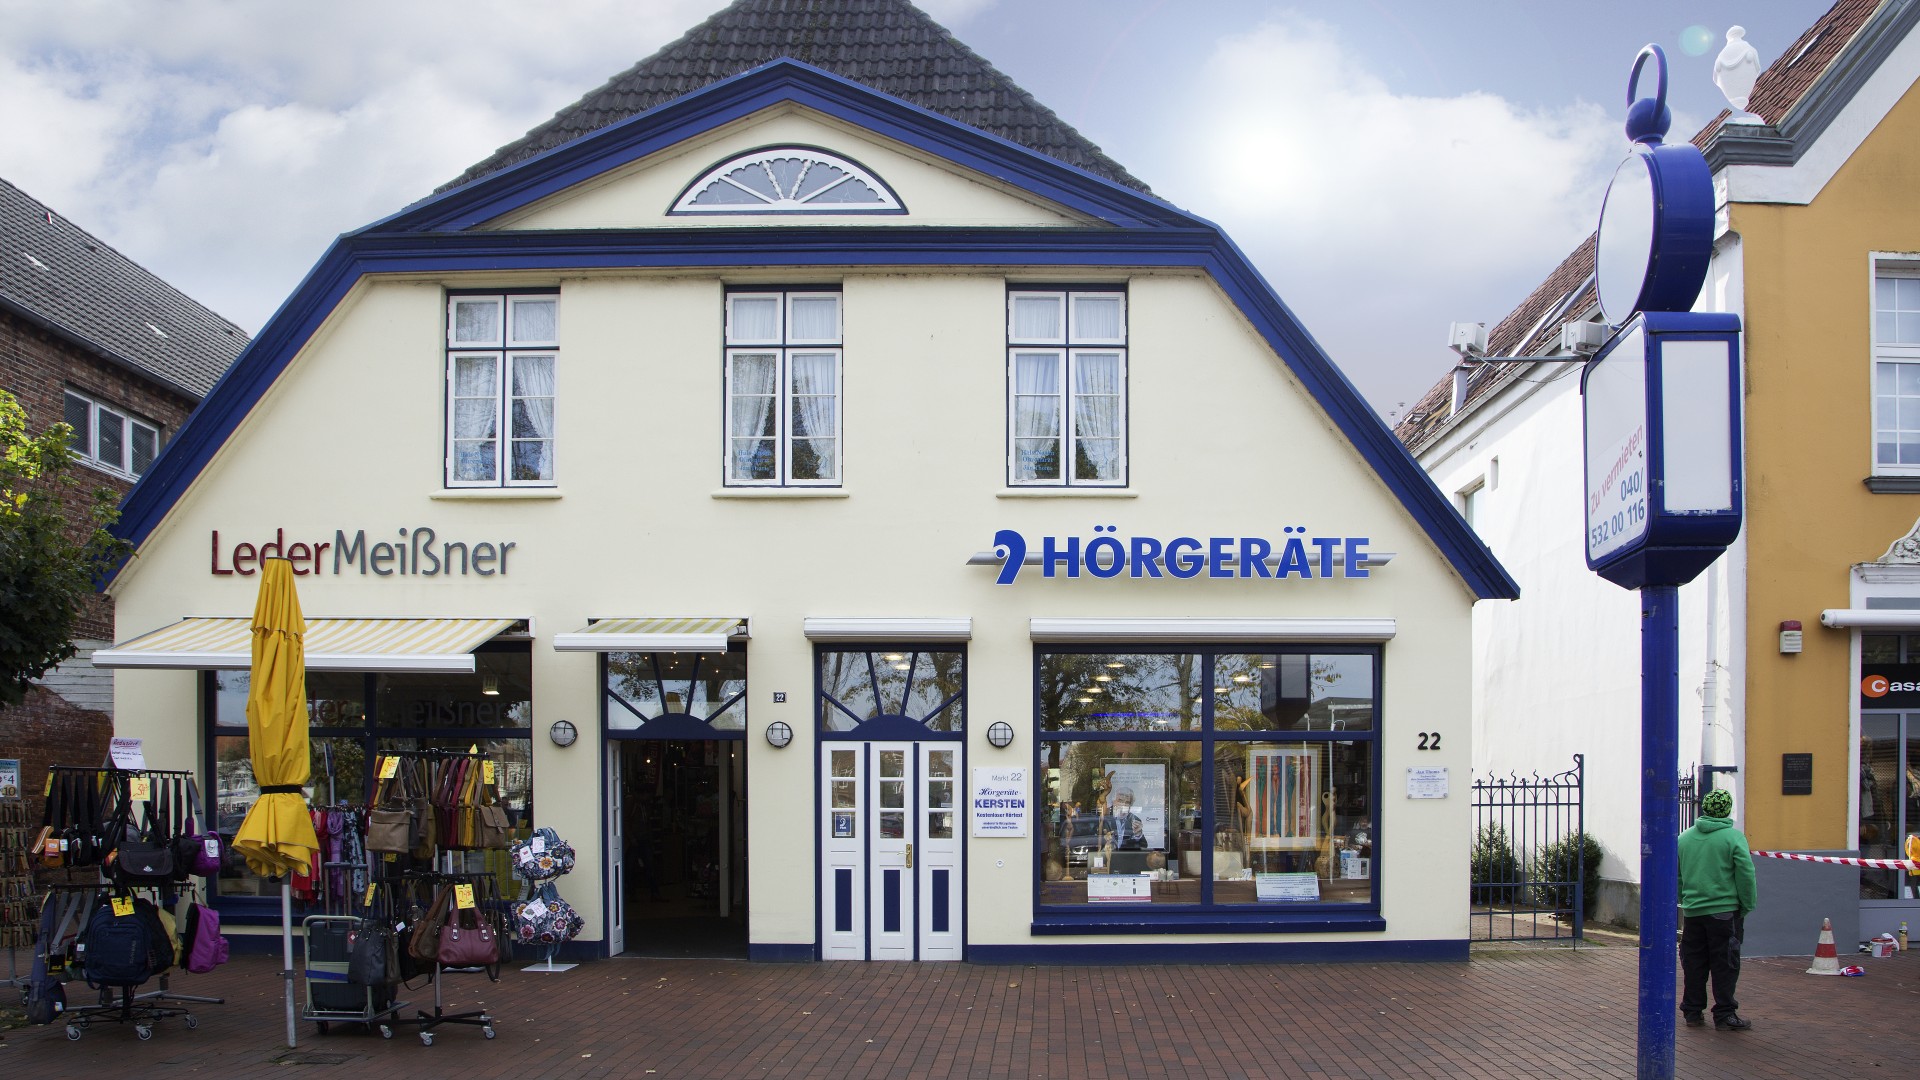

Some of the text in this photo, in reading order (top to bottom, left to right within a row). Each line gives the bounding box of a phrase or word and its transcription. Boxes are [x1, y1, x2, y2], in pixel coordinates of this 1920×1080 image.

[1591, 424, 1643, 516] Zu vermieten
[1620, 466, 1644, 502] 040/
[1591, 497, 1645, 549] 532 00 116
[1042, 525, 1370, 579] HÖRGERÄTE
[1417, 731, 1441, 751] 22
[1010, 772, 1022, 781] 22
[975, 799, 1025, 808] KERSTEN
